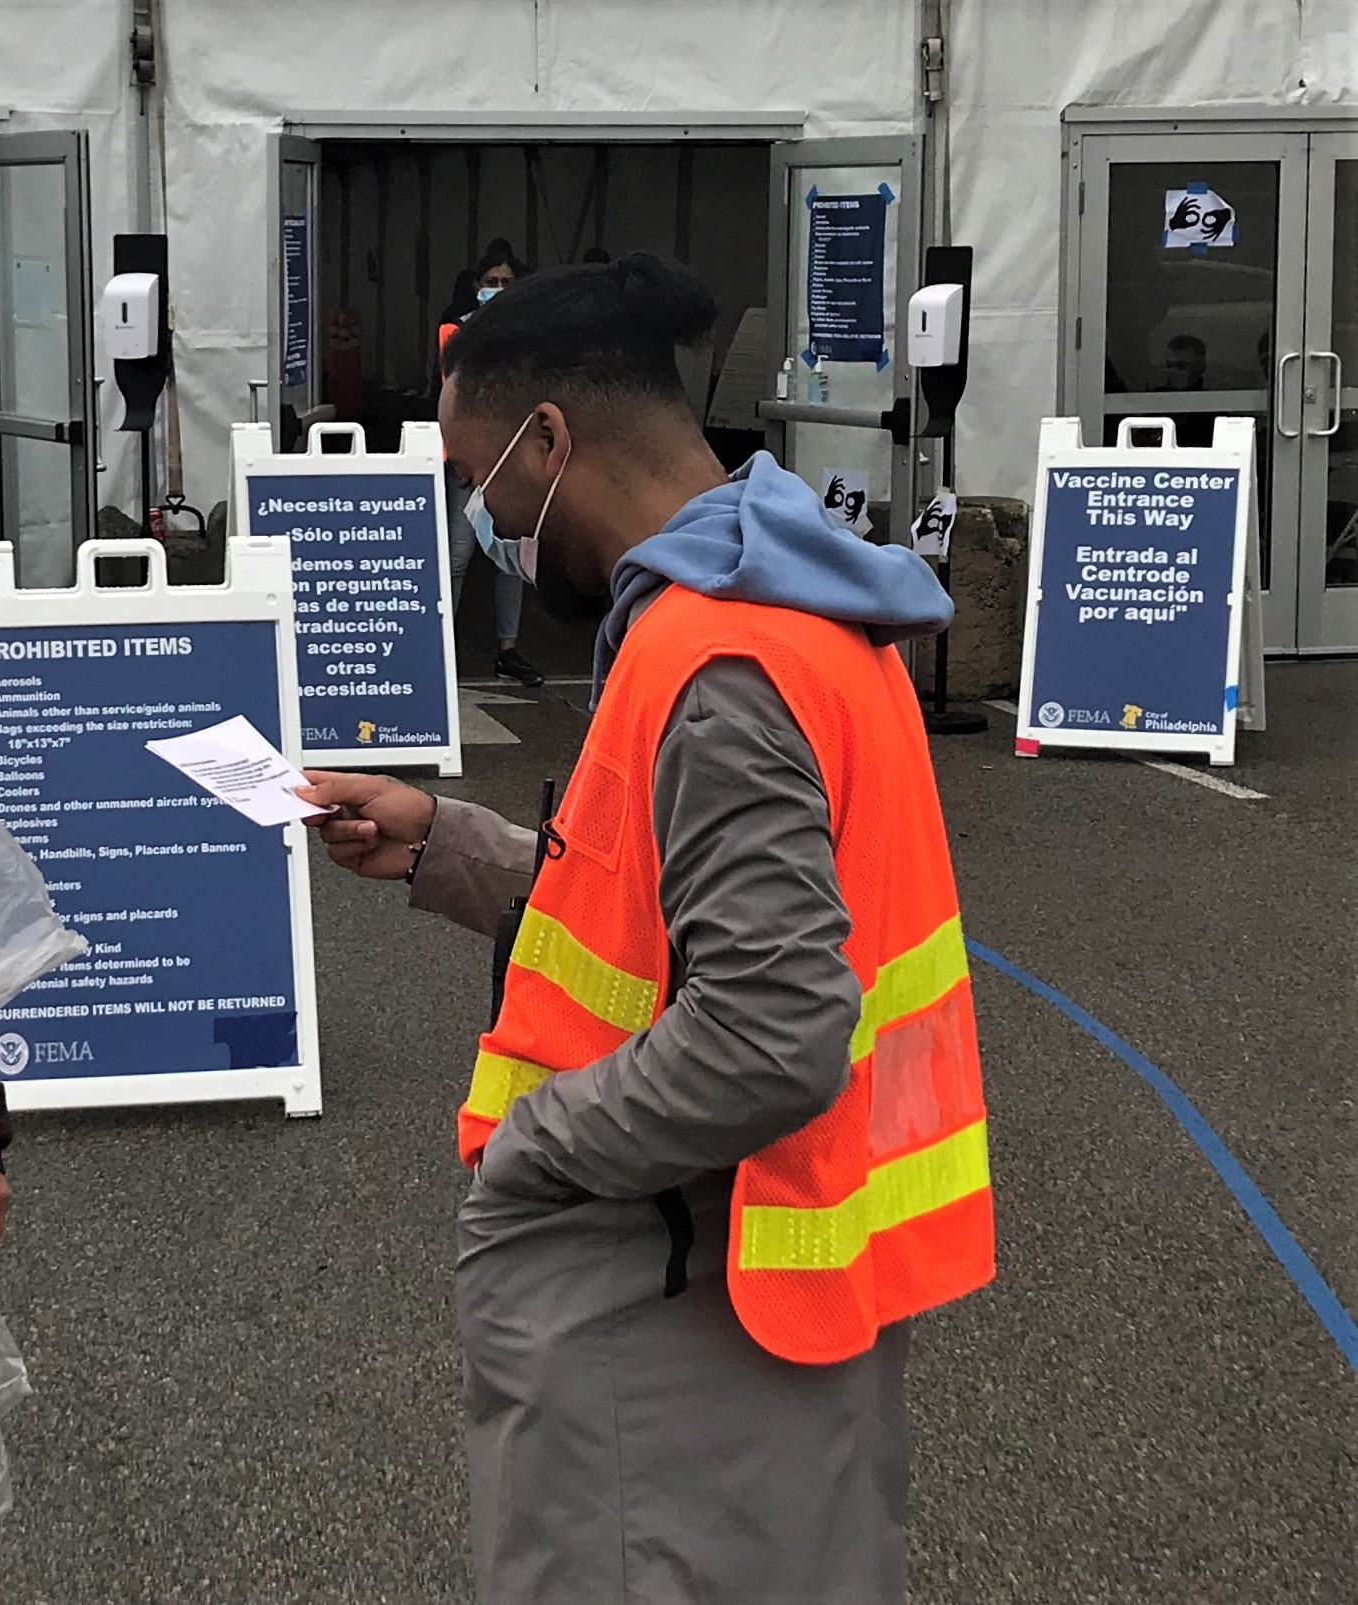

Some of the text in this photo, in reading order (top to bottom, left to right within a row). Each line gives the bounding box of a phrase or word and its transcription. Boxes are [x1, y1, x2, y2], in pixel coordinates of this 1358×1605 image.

[1053, 472, 1234, 489] Vaccine Center
[258, 497, 426, 516] ¿Necesita ayuda?
[1088, 491, 1194, 507] Entrance
[1086, 509, 1193, 530] This Way
[286, 527, 402, 544] Sólo pídala!
[1077, 546, 1197, 564] Entrada al
[292, 556, 425, 573] demos ayudar
[1082, 565, 1190, 583] Centrode
[316, 577, 418, 595] preguntas,
[1066, 584, 1203, 603] Vacunación
[326, 598, 349, 612] de
[355, 597, 426, 614] ruedas,
[1079, 607, 1118, 623] por
[295, 618, 405, 636] traducción,
[124, 637, 192, 656] ITEMS
[307, 642, 393, 656] acceso y
[326, 661, 376, 675] otras
[42, 707, 71, 716] other
[74, 706, 99, 716] than
[102, 703, 175, 715] service/guide
[178, 702, 221, 712] animals
[1067, 709, 1111, 724] FEMA
[26, 722, 83, 734] exceeding
[86, 721, 104, 731] the
[107, 720, 129, 730] size
[132, 718, 192, 729] restriction:
[1145, 719, 1217, 733] Philadelphia
[379, 732, 441, 744] Philadelphia
[40, 801, 61, 811] and
[64, 800, 93, 811] other
[96, 797, 153, 809] unmanned
[156, 796, 197, 807] aircraft
[40, 848, 95, 859] Handbills,
[99, 847, 132, 859] Signs,
[135, 844, 184, 855] Placards
[187, 845, 198, 854] or
[201, 843, 247, 852] Banners
[73, 911, 103, 924] signs
[106, 910, 127, 920] and
[130, 908, 178, 922] placards
[95, 943, 121, 953] Kind
[94, 957, 159, 970] determined
[162, 957, 173, 967] to
[176, 956, 190, 966] be
[71, 976, 106, 989] safety
[109, 974, 153, 985] hazards
[93, 1003, 131, 1015] ITEMS
[134, 1002, 165, 1013] WILL
[168, 1000, 194, 1012] NOT
[198, 999, 214, 1010] BE
[218, 996, 285, 1009] RETURNED
[35, 1041, 94, 1063] FEMA
